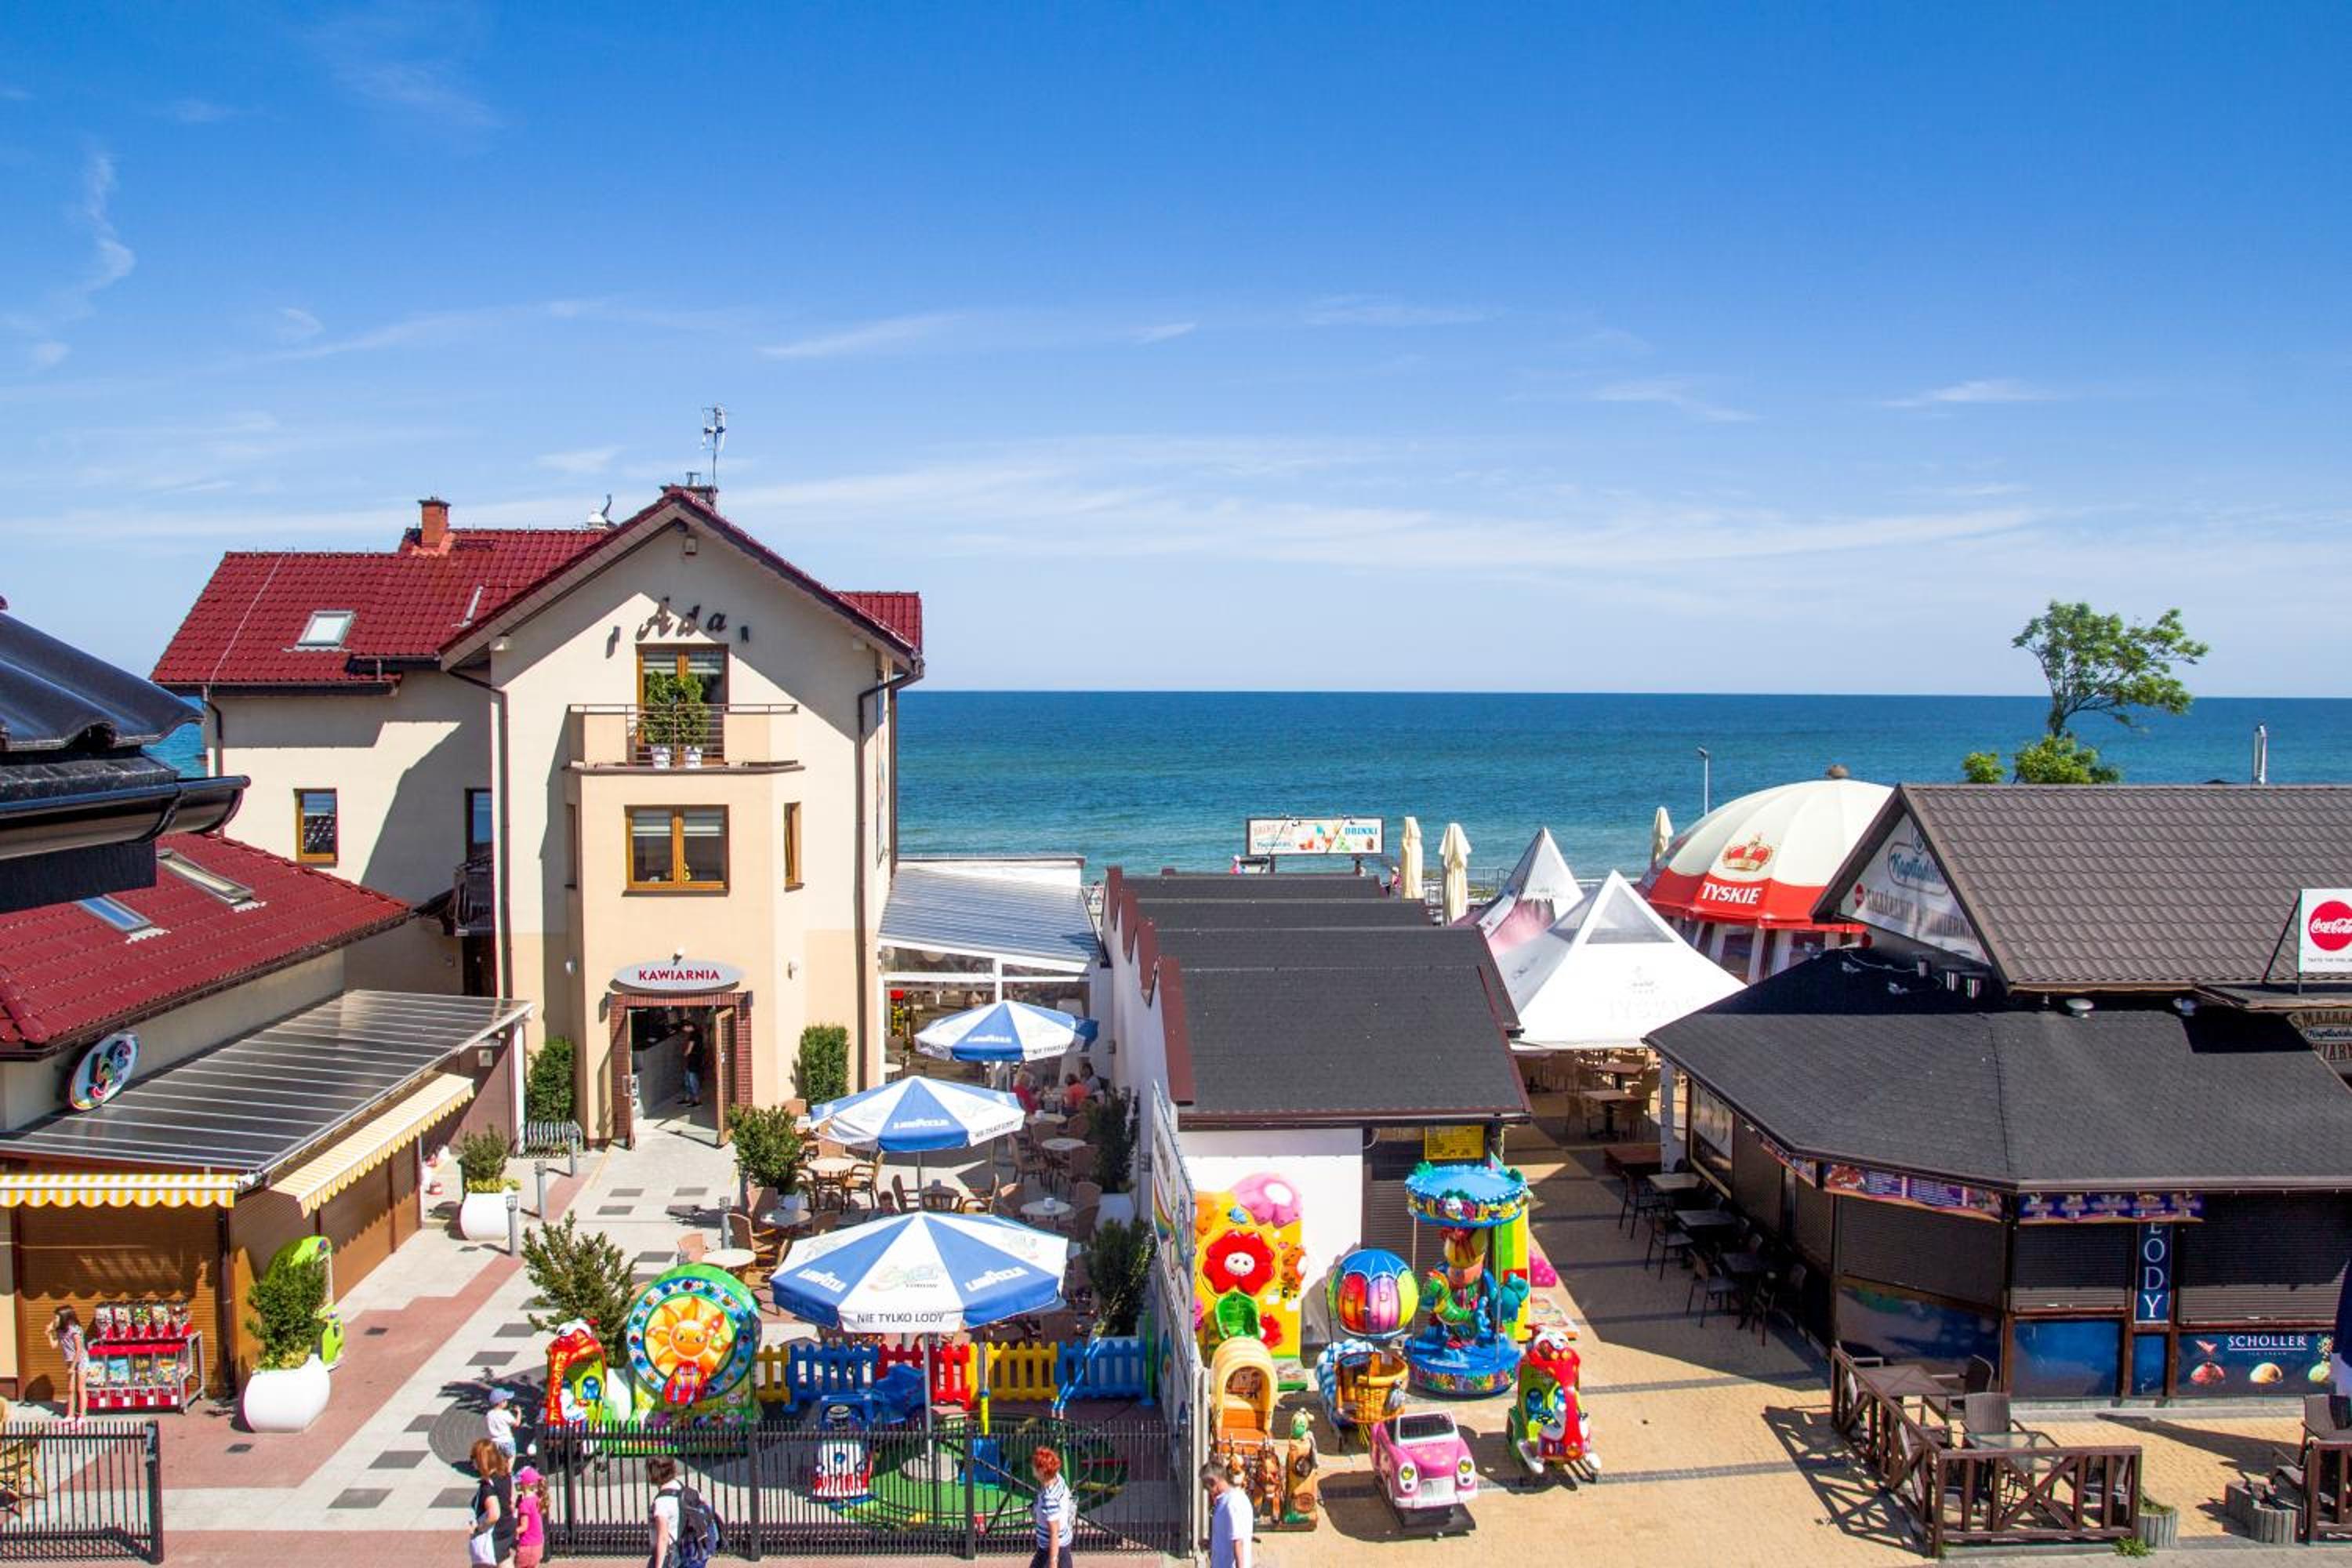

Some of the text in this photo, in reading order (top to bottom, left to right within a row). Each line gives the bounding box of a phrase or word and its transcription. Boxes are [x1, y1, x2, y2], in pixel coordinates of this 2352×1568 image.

[636, 596, 727, 641] Ada
[1701, 880, 1763, 905] TYSKIE
[638, 970, 720, 981] KAWIARNIA
[857, 1312, 945, 1323] NIE TYLKO LODY
